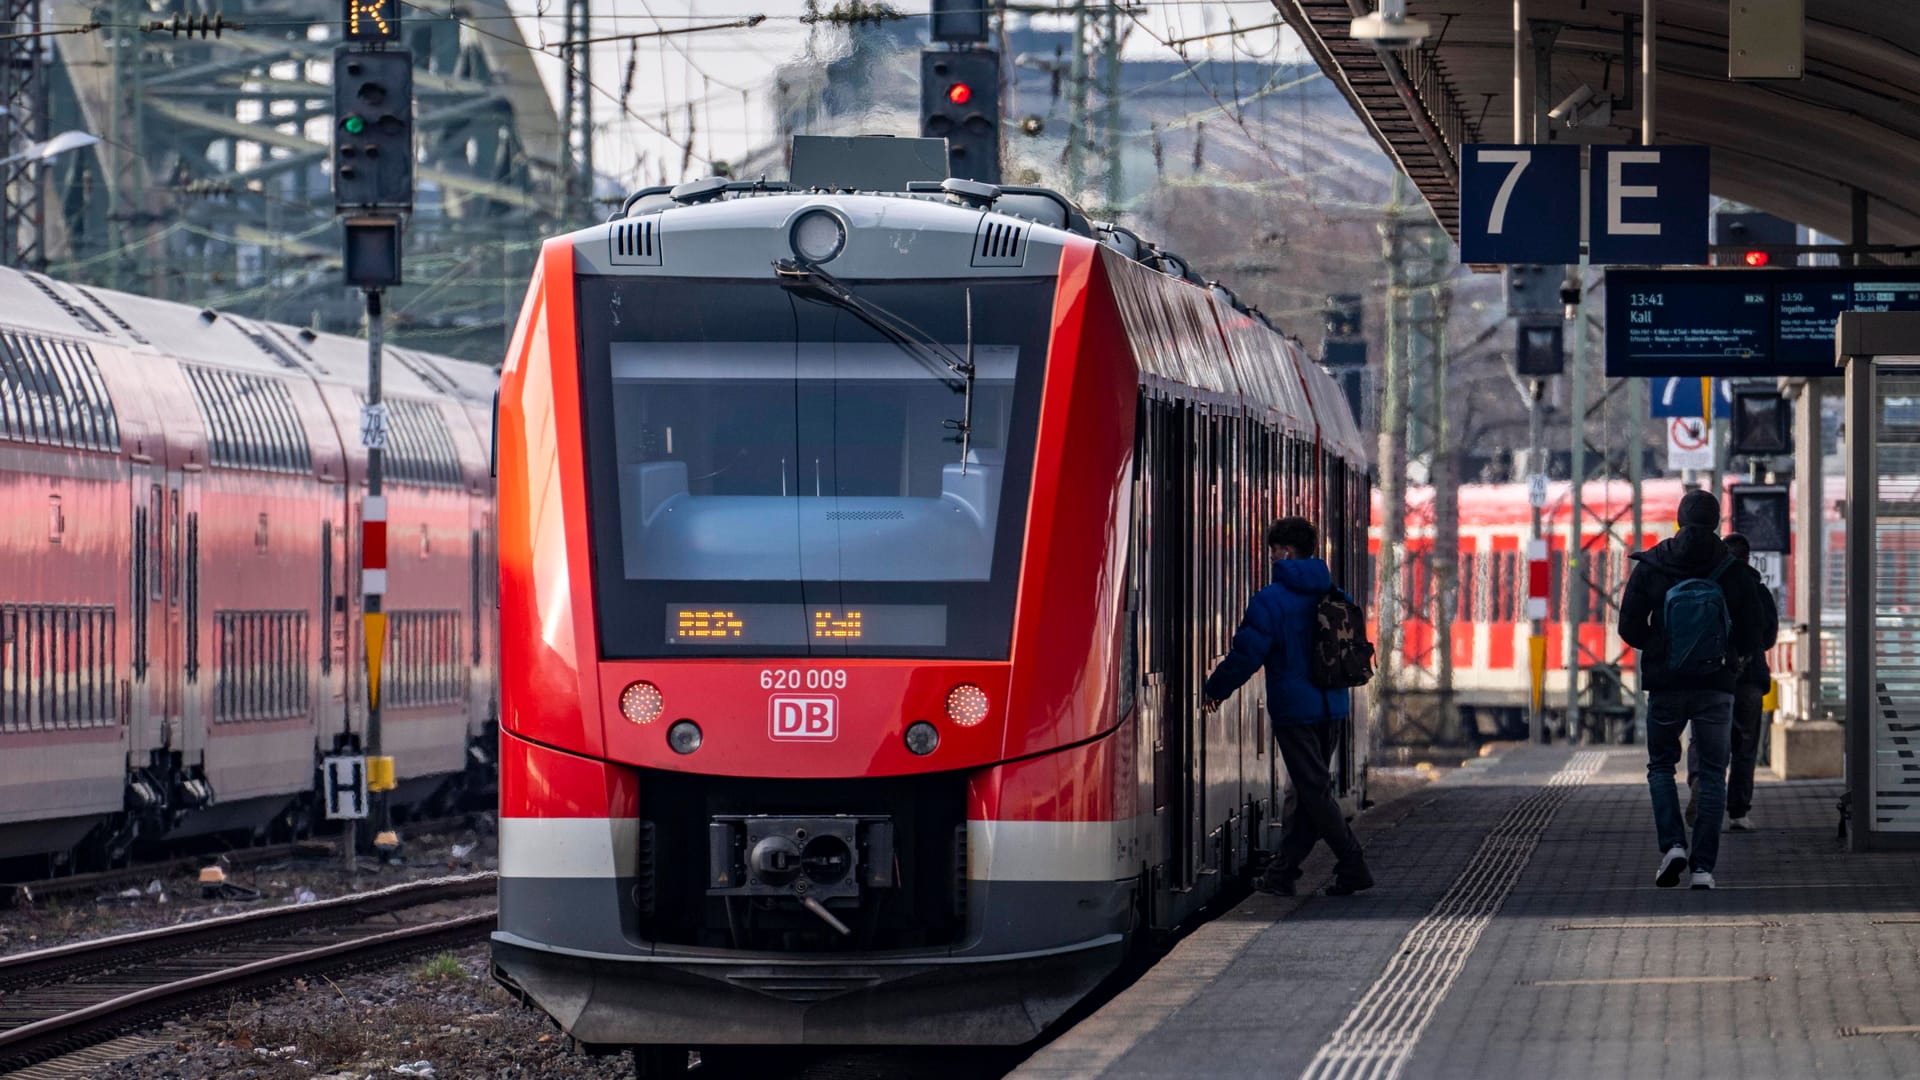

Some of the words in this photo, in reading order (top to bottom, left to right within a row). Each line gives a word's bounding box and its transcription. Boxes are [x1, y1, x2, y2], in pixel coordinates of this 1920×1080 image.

[1487, 150, 1532, 234] 7
[1607, 151, 1661, 235] E
[1630, 293, 1664, 306] 13:41
[1630, 310, 1652, 323] Kall
[1781, 304, 1815, 315] Ingelheim
[367, 413, 381, 430] 70
[760, 669, 801, 689] 620
[806, 669, 847, 689] 009
[778, 702, 830, 733] DB
[329, 763, 361, 813] H
